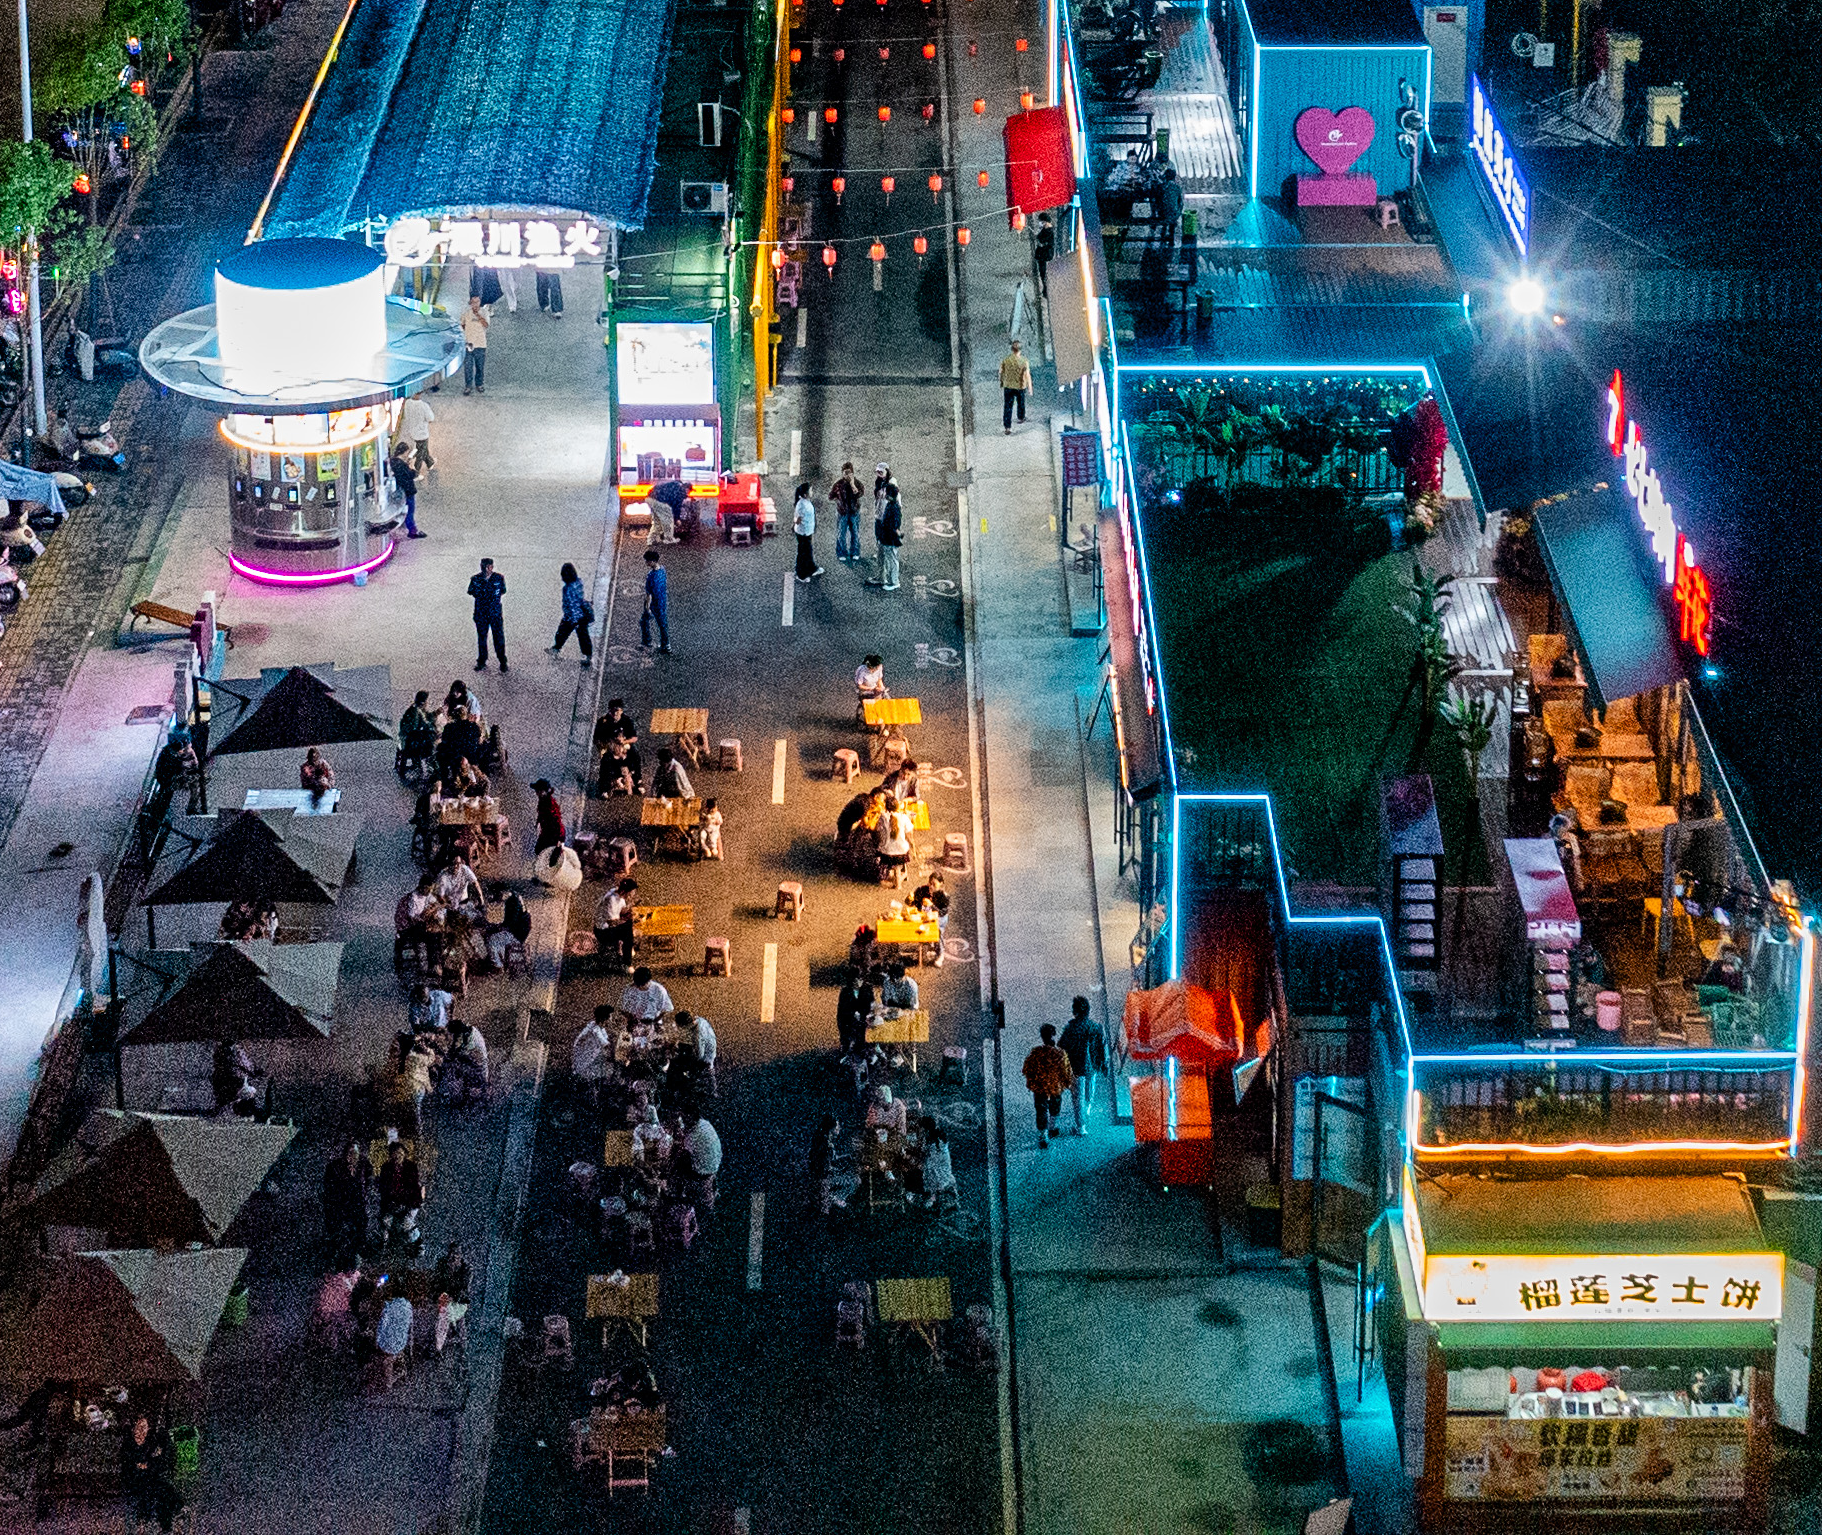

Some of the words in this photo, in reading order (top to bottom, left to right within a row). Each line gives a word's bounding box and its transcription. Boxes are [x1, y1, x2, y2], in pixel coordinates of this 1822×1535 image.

[1519, 1274, 1762, 1311] 榴莲芝士饼
